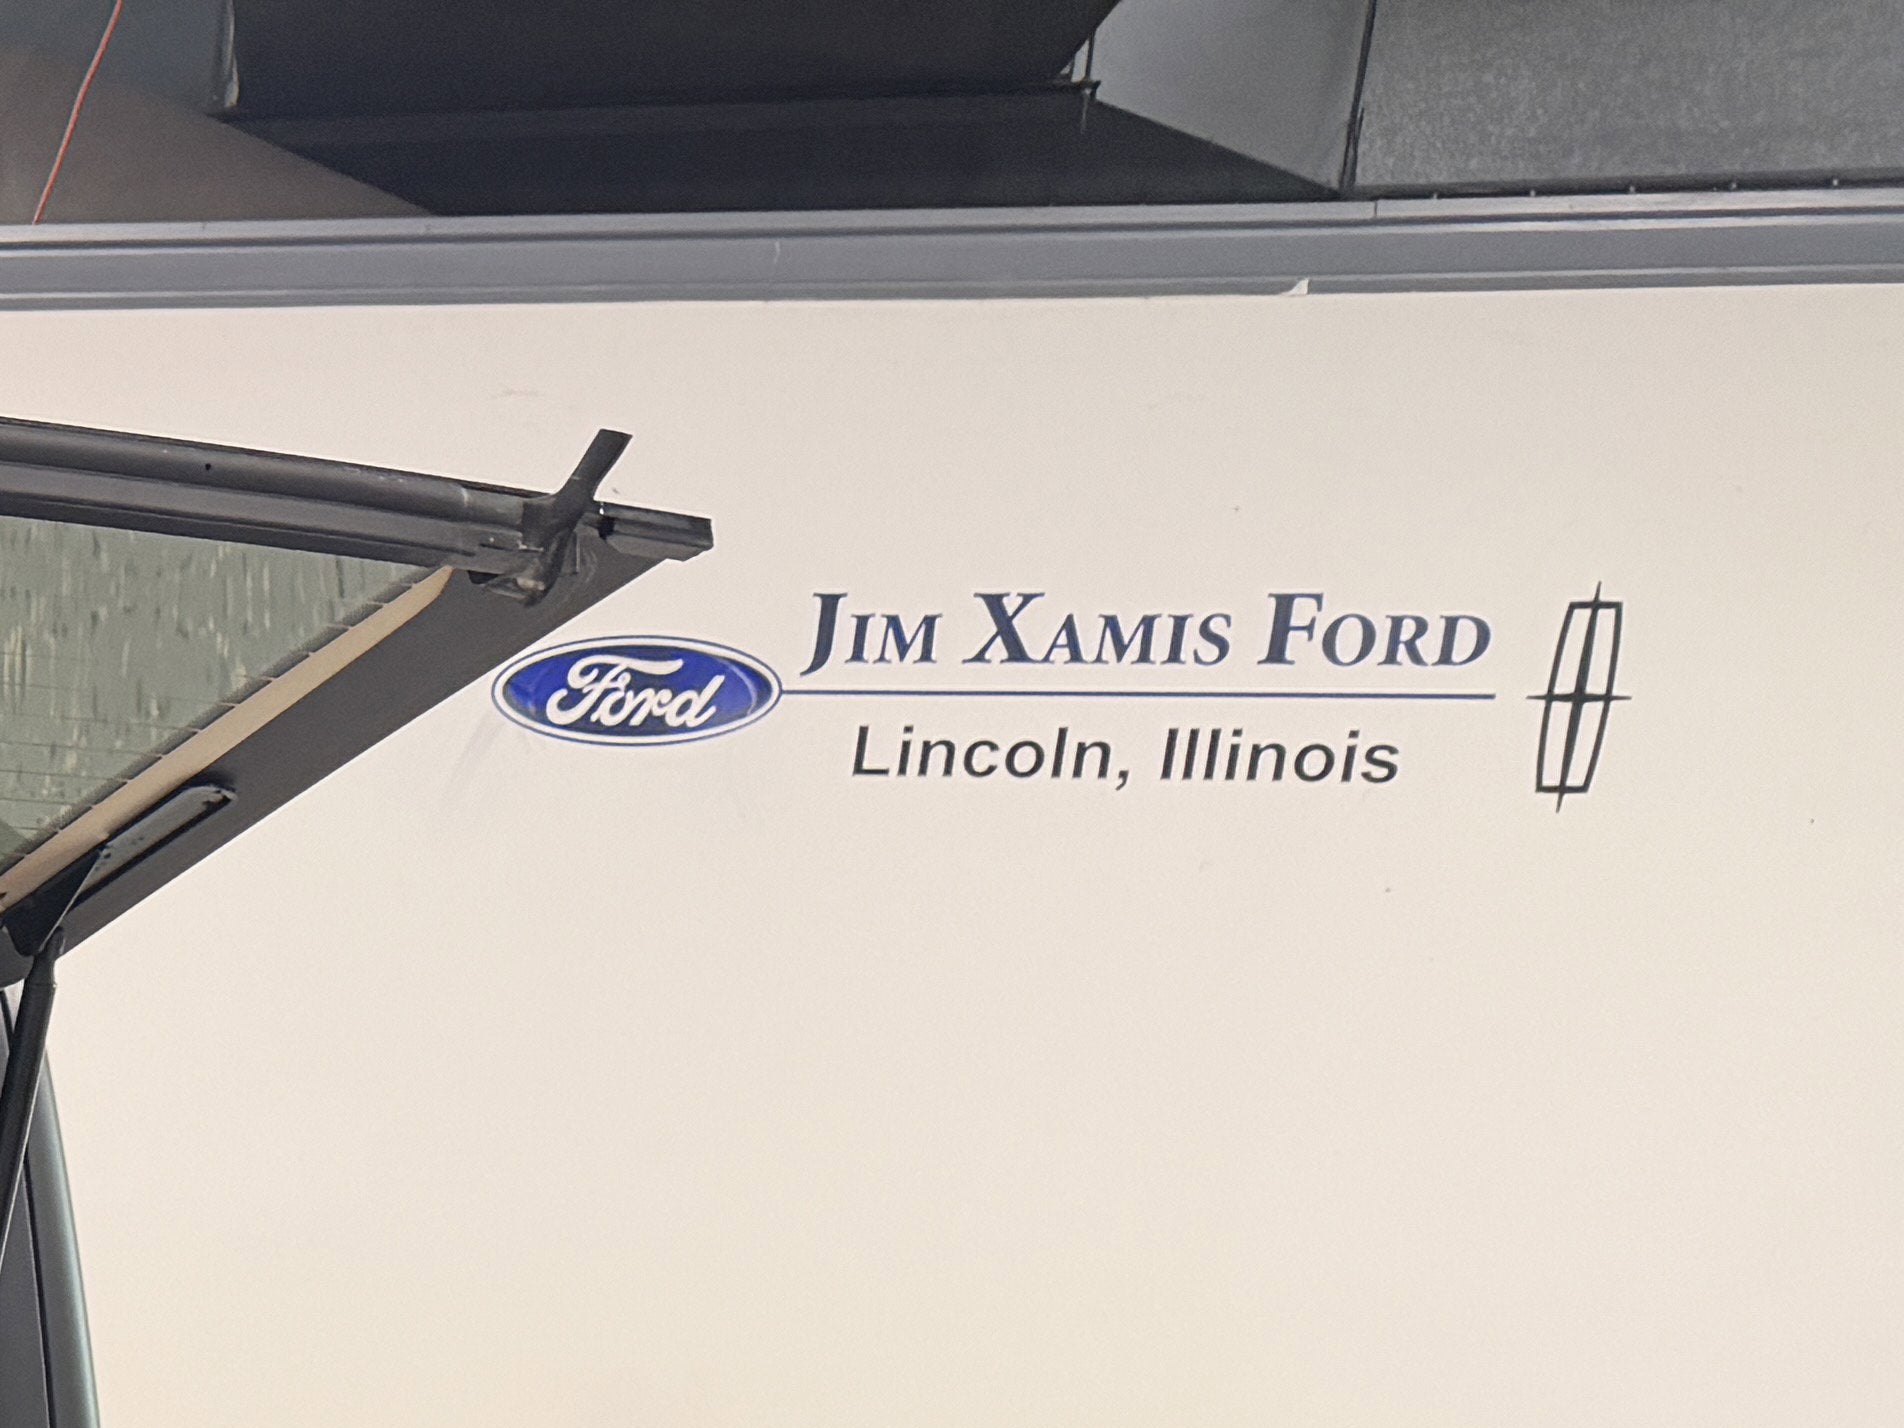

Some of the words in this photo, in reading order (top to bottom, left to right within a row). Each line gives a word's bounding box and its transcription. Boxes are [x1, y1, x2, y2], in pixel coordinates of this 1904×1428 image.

[800, 591, 943, 677] JIM
[962, 590, 1232, 669] XAMIS
[1257, 592, 1493, 668] FORD
[545, 657, 716, 730] Ford
[850, 725, 1134, 790] Lincoln,
[1160, 726, 1400, 785] Illinois
